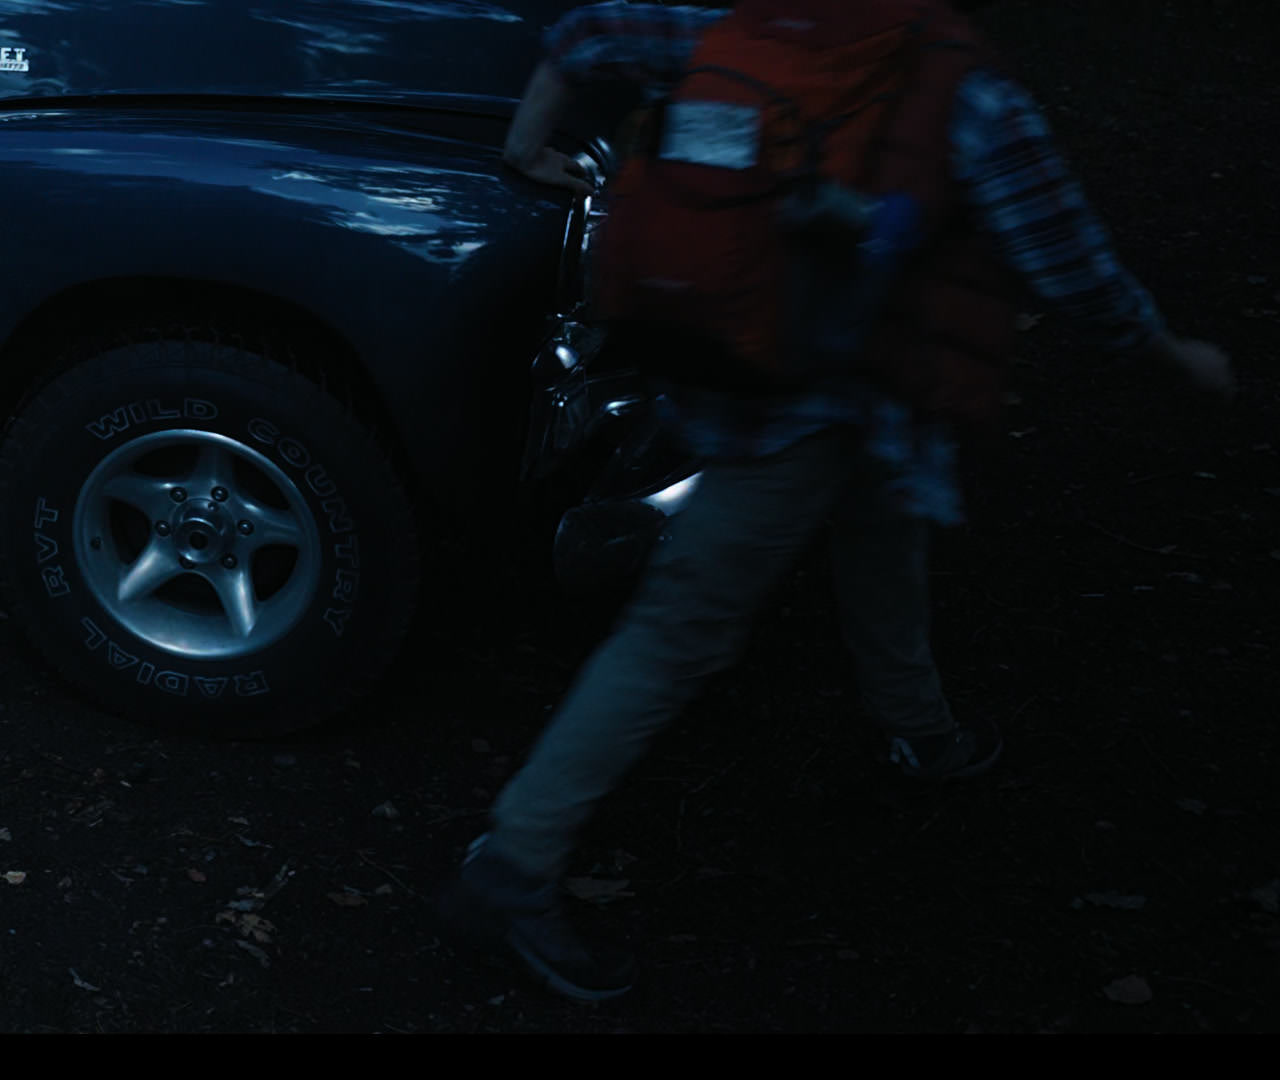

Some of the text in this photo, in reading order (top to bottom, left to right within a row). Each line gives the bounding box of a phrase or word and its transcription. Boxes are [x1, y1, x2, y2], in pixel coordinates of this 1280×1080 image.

[33, 496, 271, 698] RADIAL RVT
[84, 397, 360, 637] WILD COUNTRY
